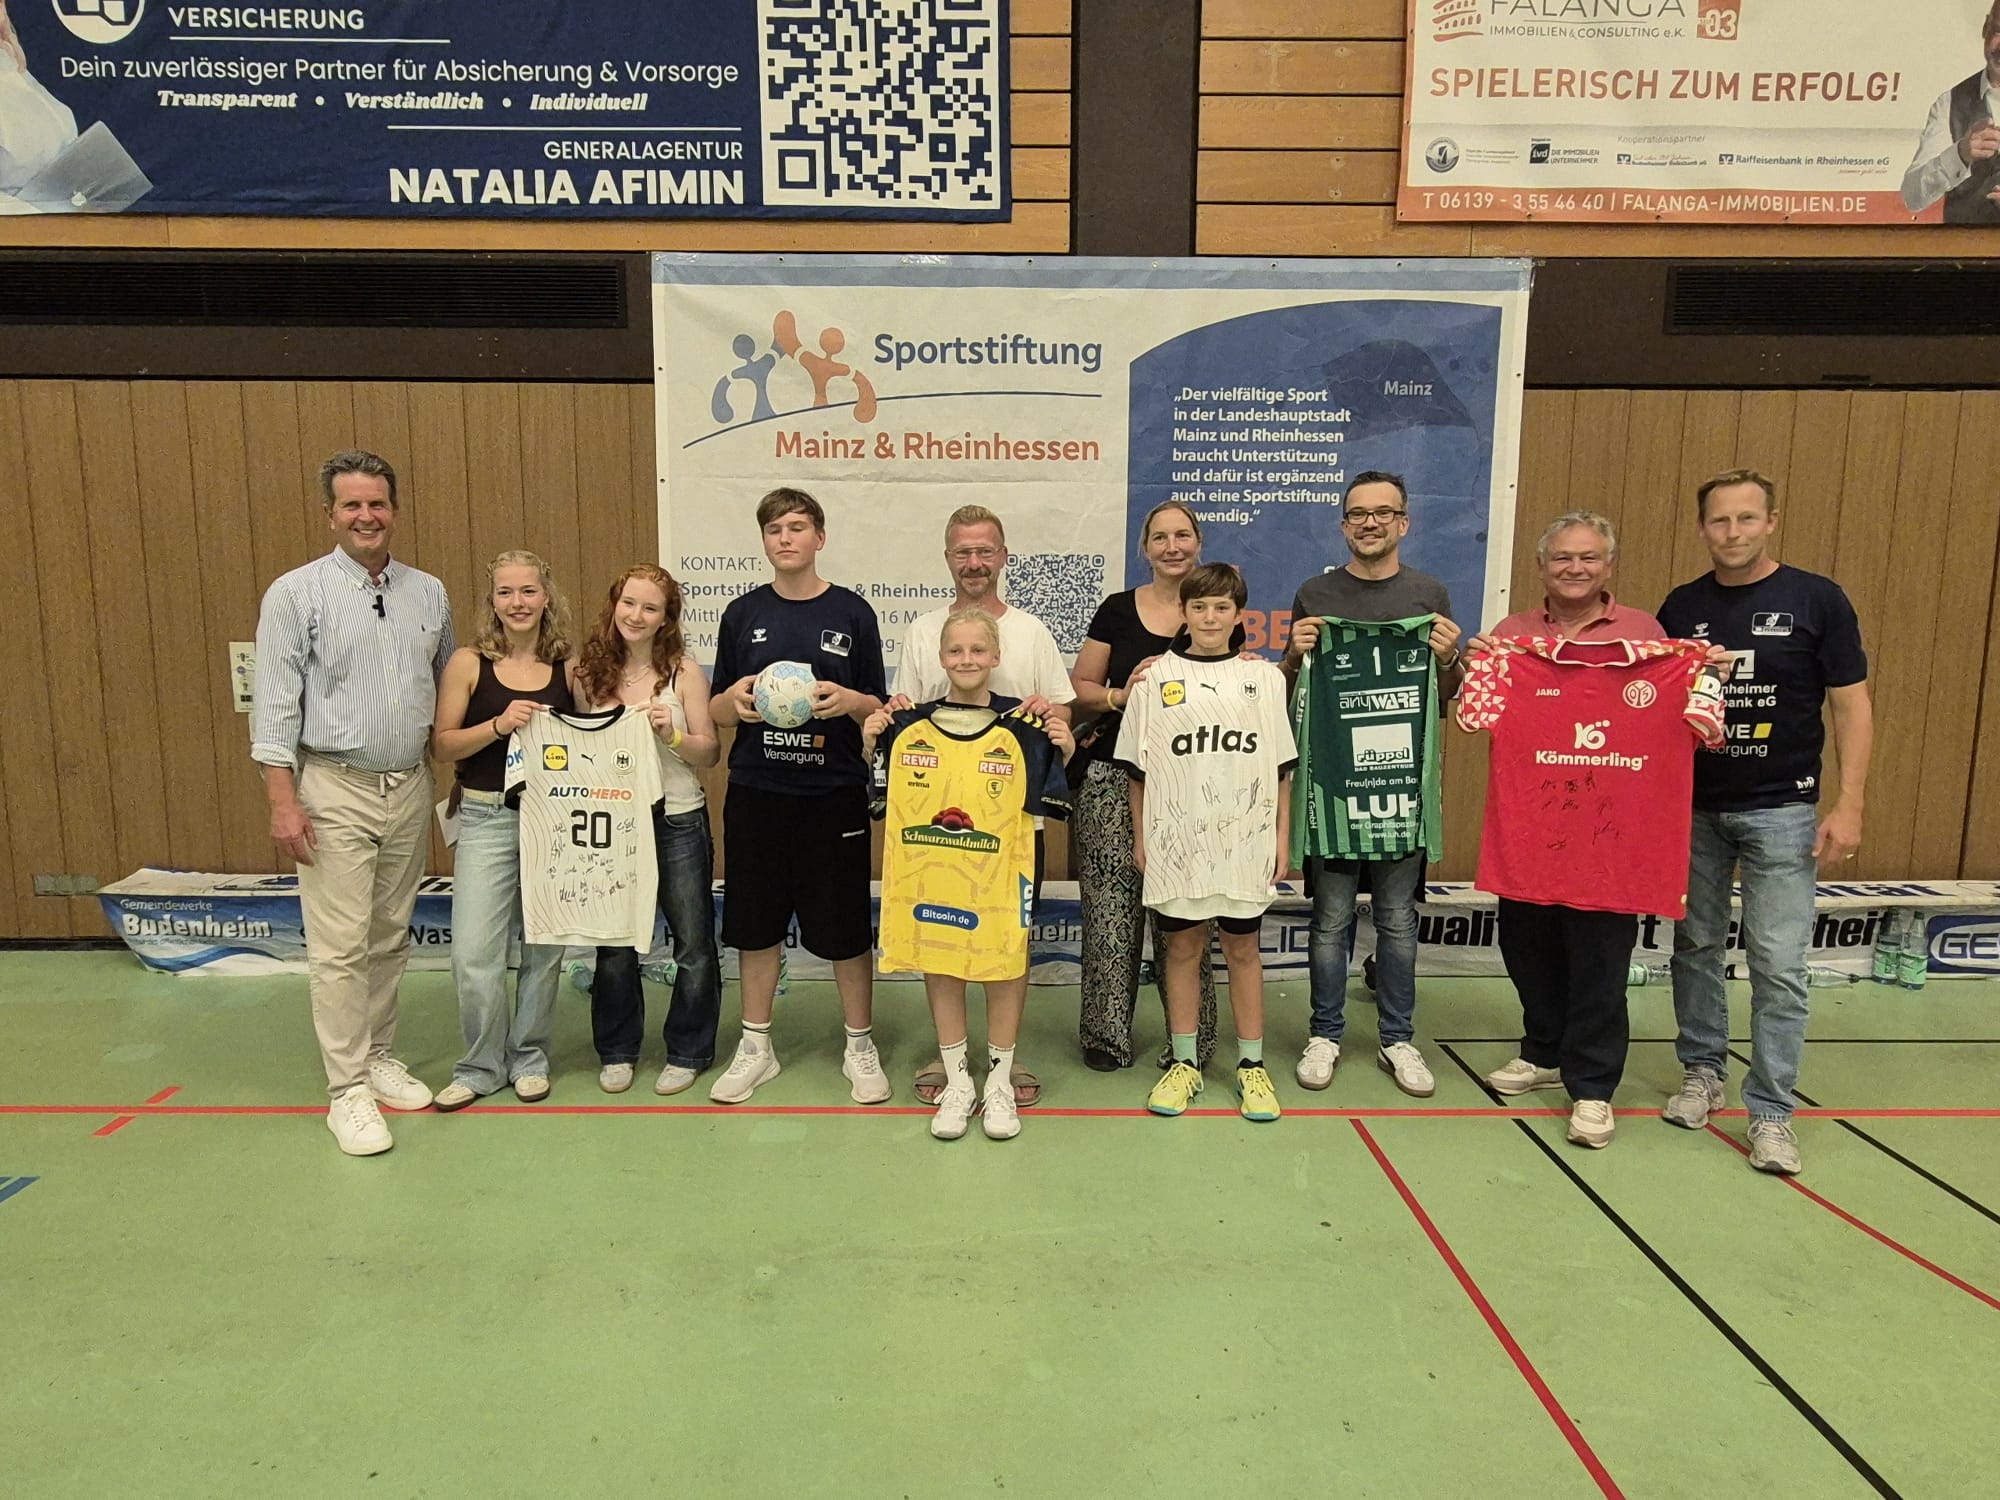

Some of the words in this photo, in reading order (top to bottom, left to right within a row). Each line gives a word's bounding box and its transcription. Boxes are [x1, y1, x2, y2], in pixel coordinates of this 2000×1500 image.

[1491, 0, 1685, 17] FALANGA
[168, 7, 365, 30] VERSICHERUNG
[1663, 27, 1686, 38] e.K.
[61, 56, 116, 79] Dein
[123, 58, 287, 86] zuverlässiger
[295, 59, 385, 81] Partner
[393, 59, 426, 82] für
[434, 59, 592, 87] Absicherung
[599, 62, 618, 82] &
[625, 61, 738, 87] Vorsorge
[1430, 67, 1659, 100] SPIELERISCH
[1670, 69, 1740, 102] ZUM
[1751, 71, 1901, 103] ERFOLG!
[157, 90, 298, 111] Transparent
[344, 90, 484, 112] Verständlich
[529, 92, 648, 112] Individuell
[543, 140, 744, 160] GENERALAGENTUR
[1736, 154, 1802, 166] Raiffeisenbank
[1804, 156, 1814, 166] in
[1817, 156, 1875, 167] Rheinhessen
[1877, 157, 1890, 167] eG
[389, 167, 579, 205] NATALIA
[589, 169, 744, 205] AFIMIN
[1423, 193, 1435, 209] T
[1440, 192, 1494, 209] 06139
[1512, 194, 1522, 210] 3
[1529, 194, 1549, 210] 55
[1554, 194, 1576, 210] 46
[1582, 193, 1604, 210] 40
[1622, 193, 1867, 213] FALANGA-IMMOBILIEN.DE
[873, 333, 1102, 373] Sportstiftung
[1211, 388, 1285, 405] vielfältige
[1287, 388, 1328, 405] Sport
[1384, 380, 1433, 396] Mainz
[1174, 408, 1188, 422] in
[1190, 408, 1215, 422] der
[1218, 408, 1351, 425] Landeshauptstadt
[1173, 428, 1217, 442] Mainz
[1220, 428, 1249, 442] und
[1252, 428, 1344, 443] Rheinhessen
[775, 431, 865, 459] Mainz
[873, 432, 896, 459] &
[904, 432, 1100, 460] Rheinhessen
[1172, 449, 1229, 463] braucht
[1231, 448, 1338, 466] Unterstützung
[1172, 469, 1200, 483] und
[1203, 469, 1243, 484] dafür
[1245, 469, 1264, 483] ist
[1266, 469, 1344, 486] ergänzend
[1171, 489, 1207, 503] auch
[1209, 489, 1240, 503] eine
[1243, 489, 1340, 507] Sportstiftung
[1195, 508, 1261, 526] wendig.“
[680, 556, 762, 572] KONTAKT:
[871, 584, 956, 598] Rheinhess
[683, 608, 719, 623] Mittl
[683, 634, 718, 648] E-Ma
[1372, 646, 1382, 676] 1
[1536, 688, 1560, 697] JAKO
[1721, 683, 1777, 695] nheimer
[1757, 695, 1777, 708] eG
[763, 731, 812, 748] ESWE
[1171, 724, 1258, 757] atlas
[764, 748, 825, 765] Versorgung
[902, 754, 938, 768] REWE
[1356, 747, 1410, 763] rüppel
[979, 762, 1013, 775] REWE
[908, 780, 930, 789] erima
[548, 786, 633, 801] AUTOHERO
[571, 809, 612, 849] 20
[903, 830, 998, 850] Schwarzwaldmilch
[120, 898, 213, 912] Gemeindewerke
[122, 913, 272, 938] Budenheim
[1416, 910, 1497, 946] uali
[1938, 932, 2000, 959] GE
